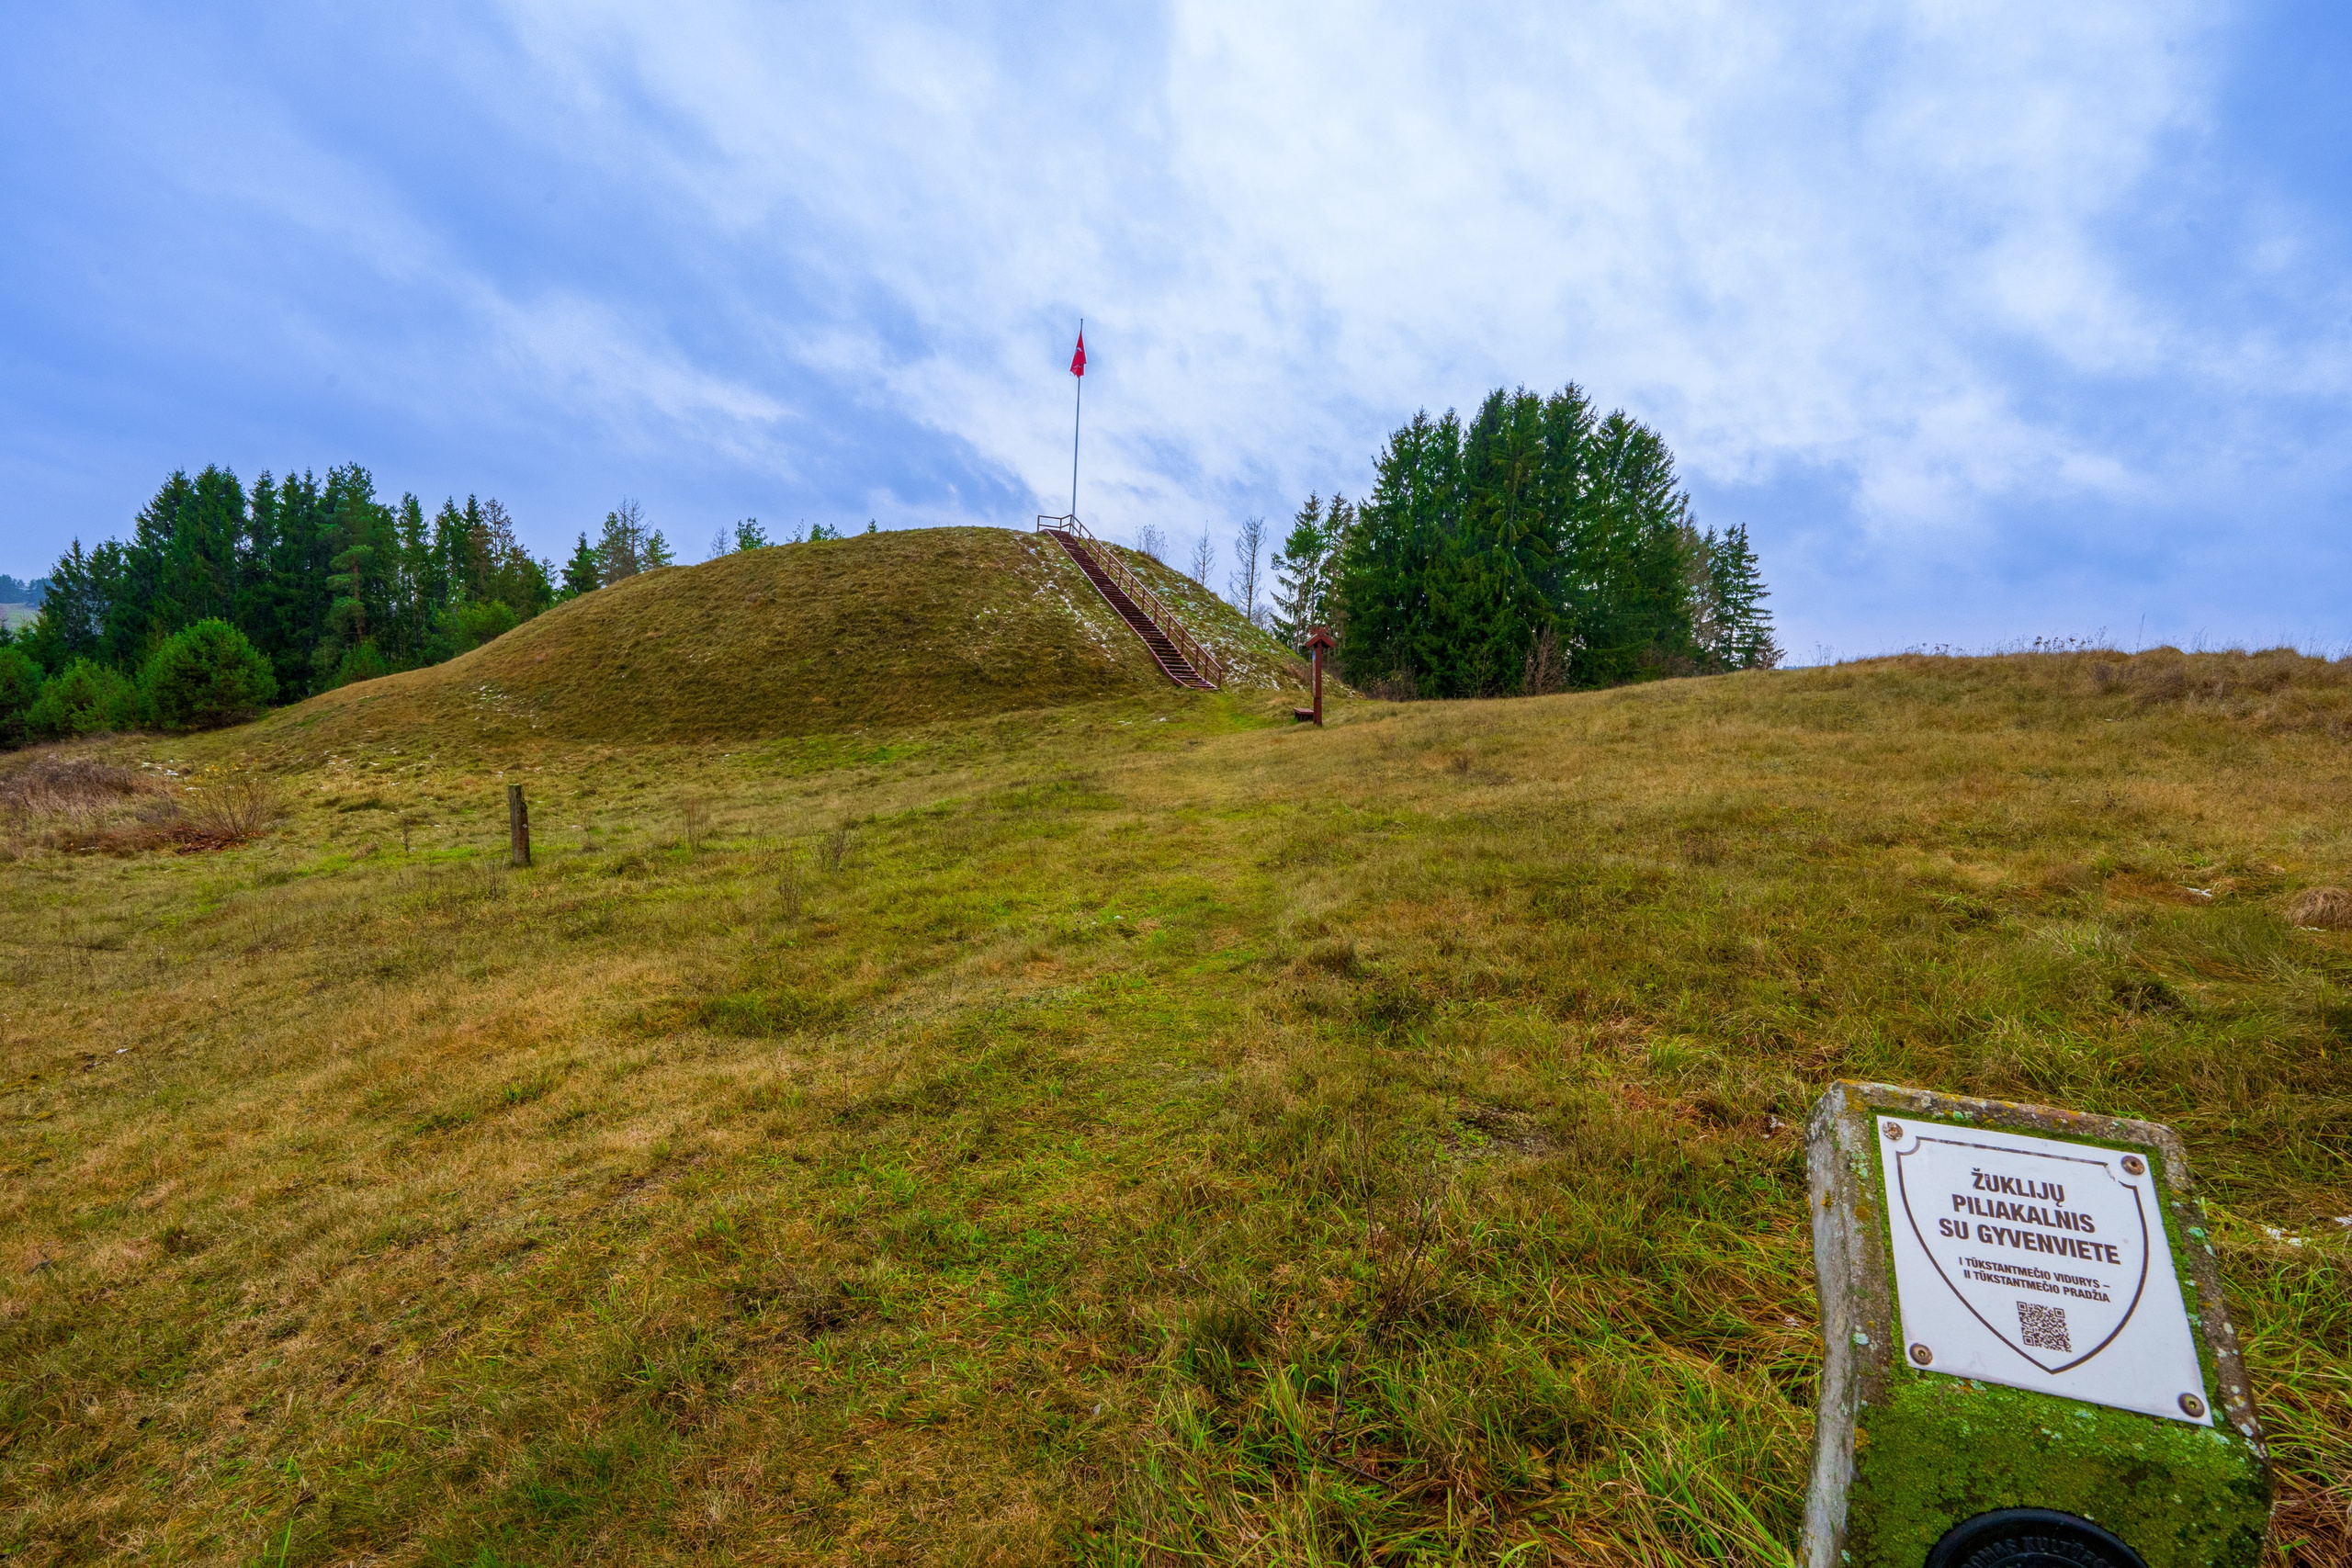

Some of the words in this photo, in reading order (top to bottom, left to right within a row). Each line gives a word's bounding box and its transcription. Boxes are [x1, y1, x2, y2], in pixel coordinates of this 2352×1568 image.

[1971, 1168, 2065, 1207] ŽUKLIJŲ
[1951, 1194, 2096, 1234] PILIAKALNIS
[1939, 1218, 1969, 1240] SU
[1977, 1224, 2121, 1265] GYVENVIETE
[1959, 1257, 1963, 1265] I
[1965, 1257, 2051, 1280] TŪKSTANTMEČIO
[2053, 1272, 2100, 1289] VIDURYS
[1963, 1269, 1971, 1279] II
[1973, 1269, 2060, 1294] TŪKSTANTMEČIO
[2064, 1287, 2110, 1303] PRADŽIA
